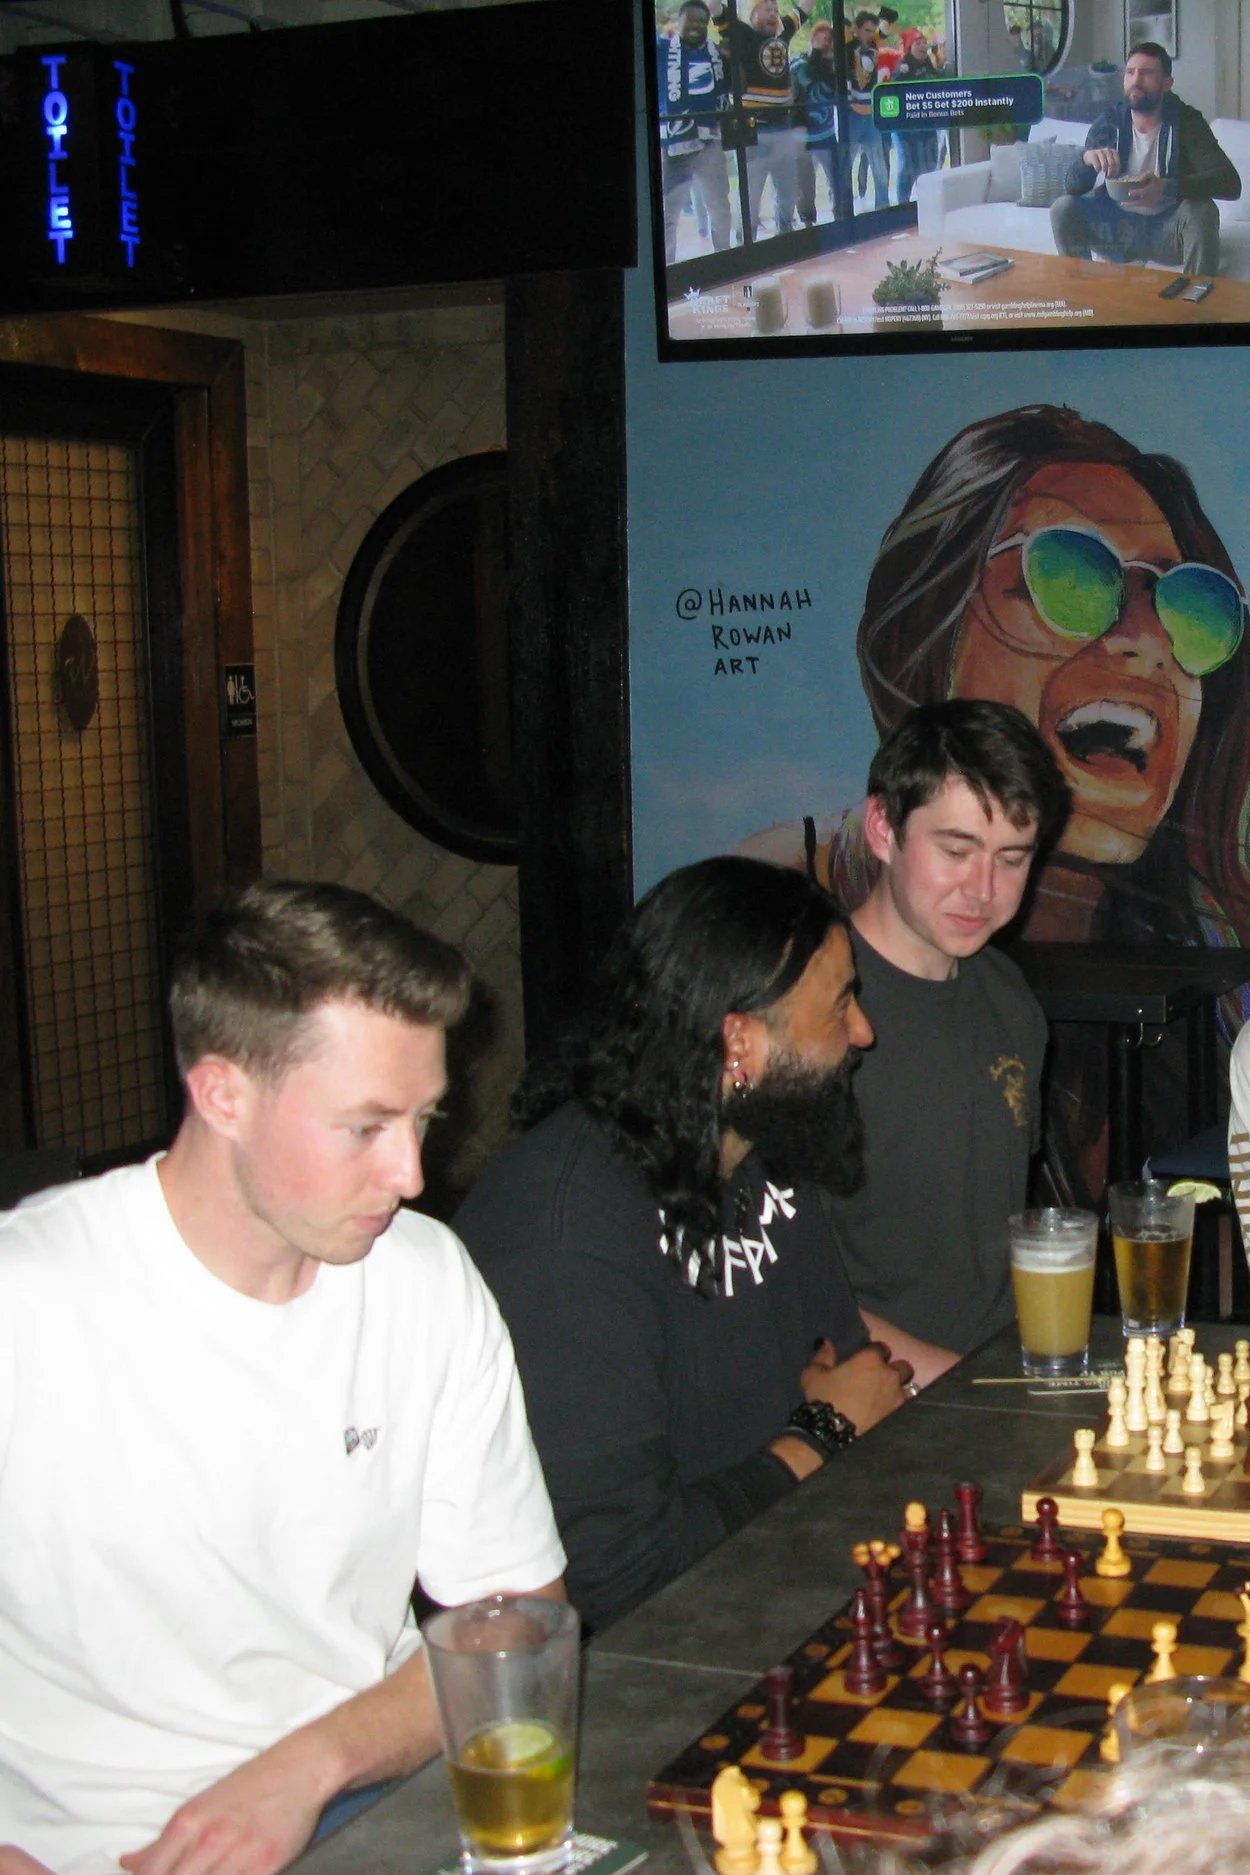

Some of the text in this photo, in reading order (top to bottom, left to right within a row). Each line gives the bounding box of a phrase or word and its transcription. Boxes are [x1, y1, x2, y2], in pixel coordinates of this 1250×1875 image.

[905, 90, 972, 101] New Customers
[905, 96, 1014, 110] Bet $5 Get $200 Instantly
[905, 111, 920, 119] Paid
[40, 54, 74, 264] TOILET
[112, 59, 141, 268] TOILET
[676, 588, 812, 620] @HANNAH
[711, 622, 792, 650] ROWAN
[714, 656, 760, 675] ART
